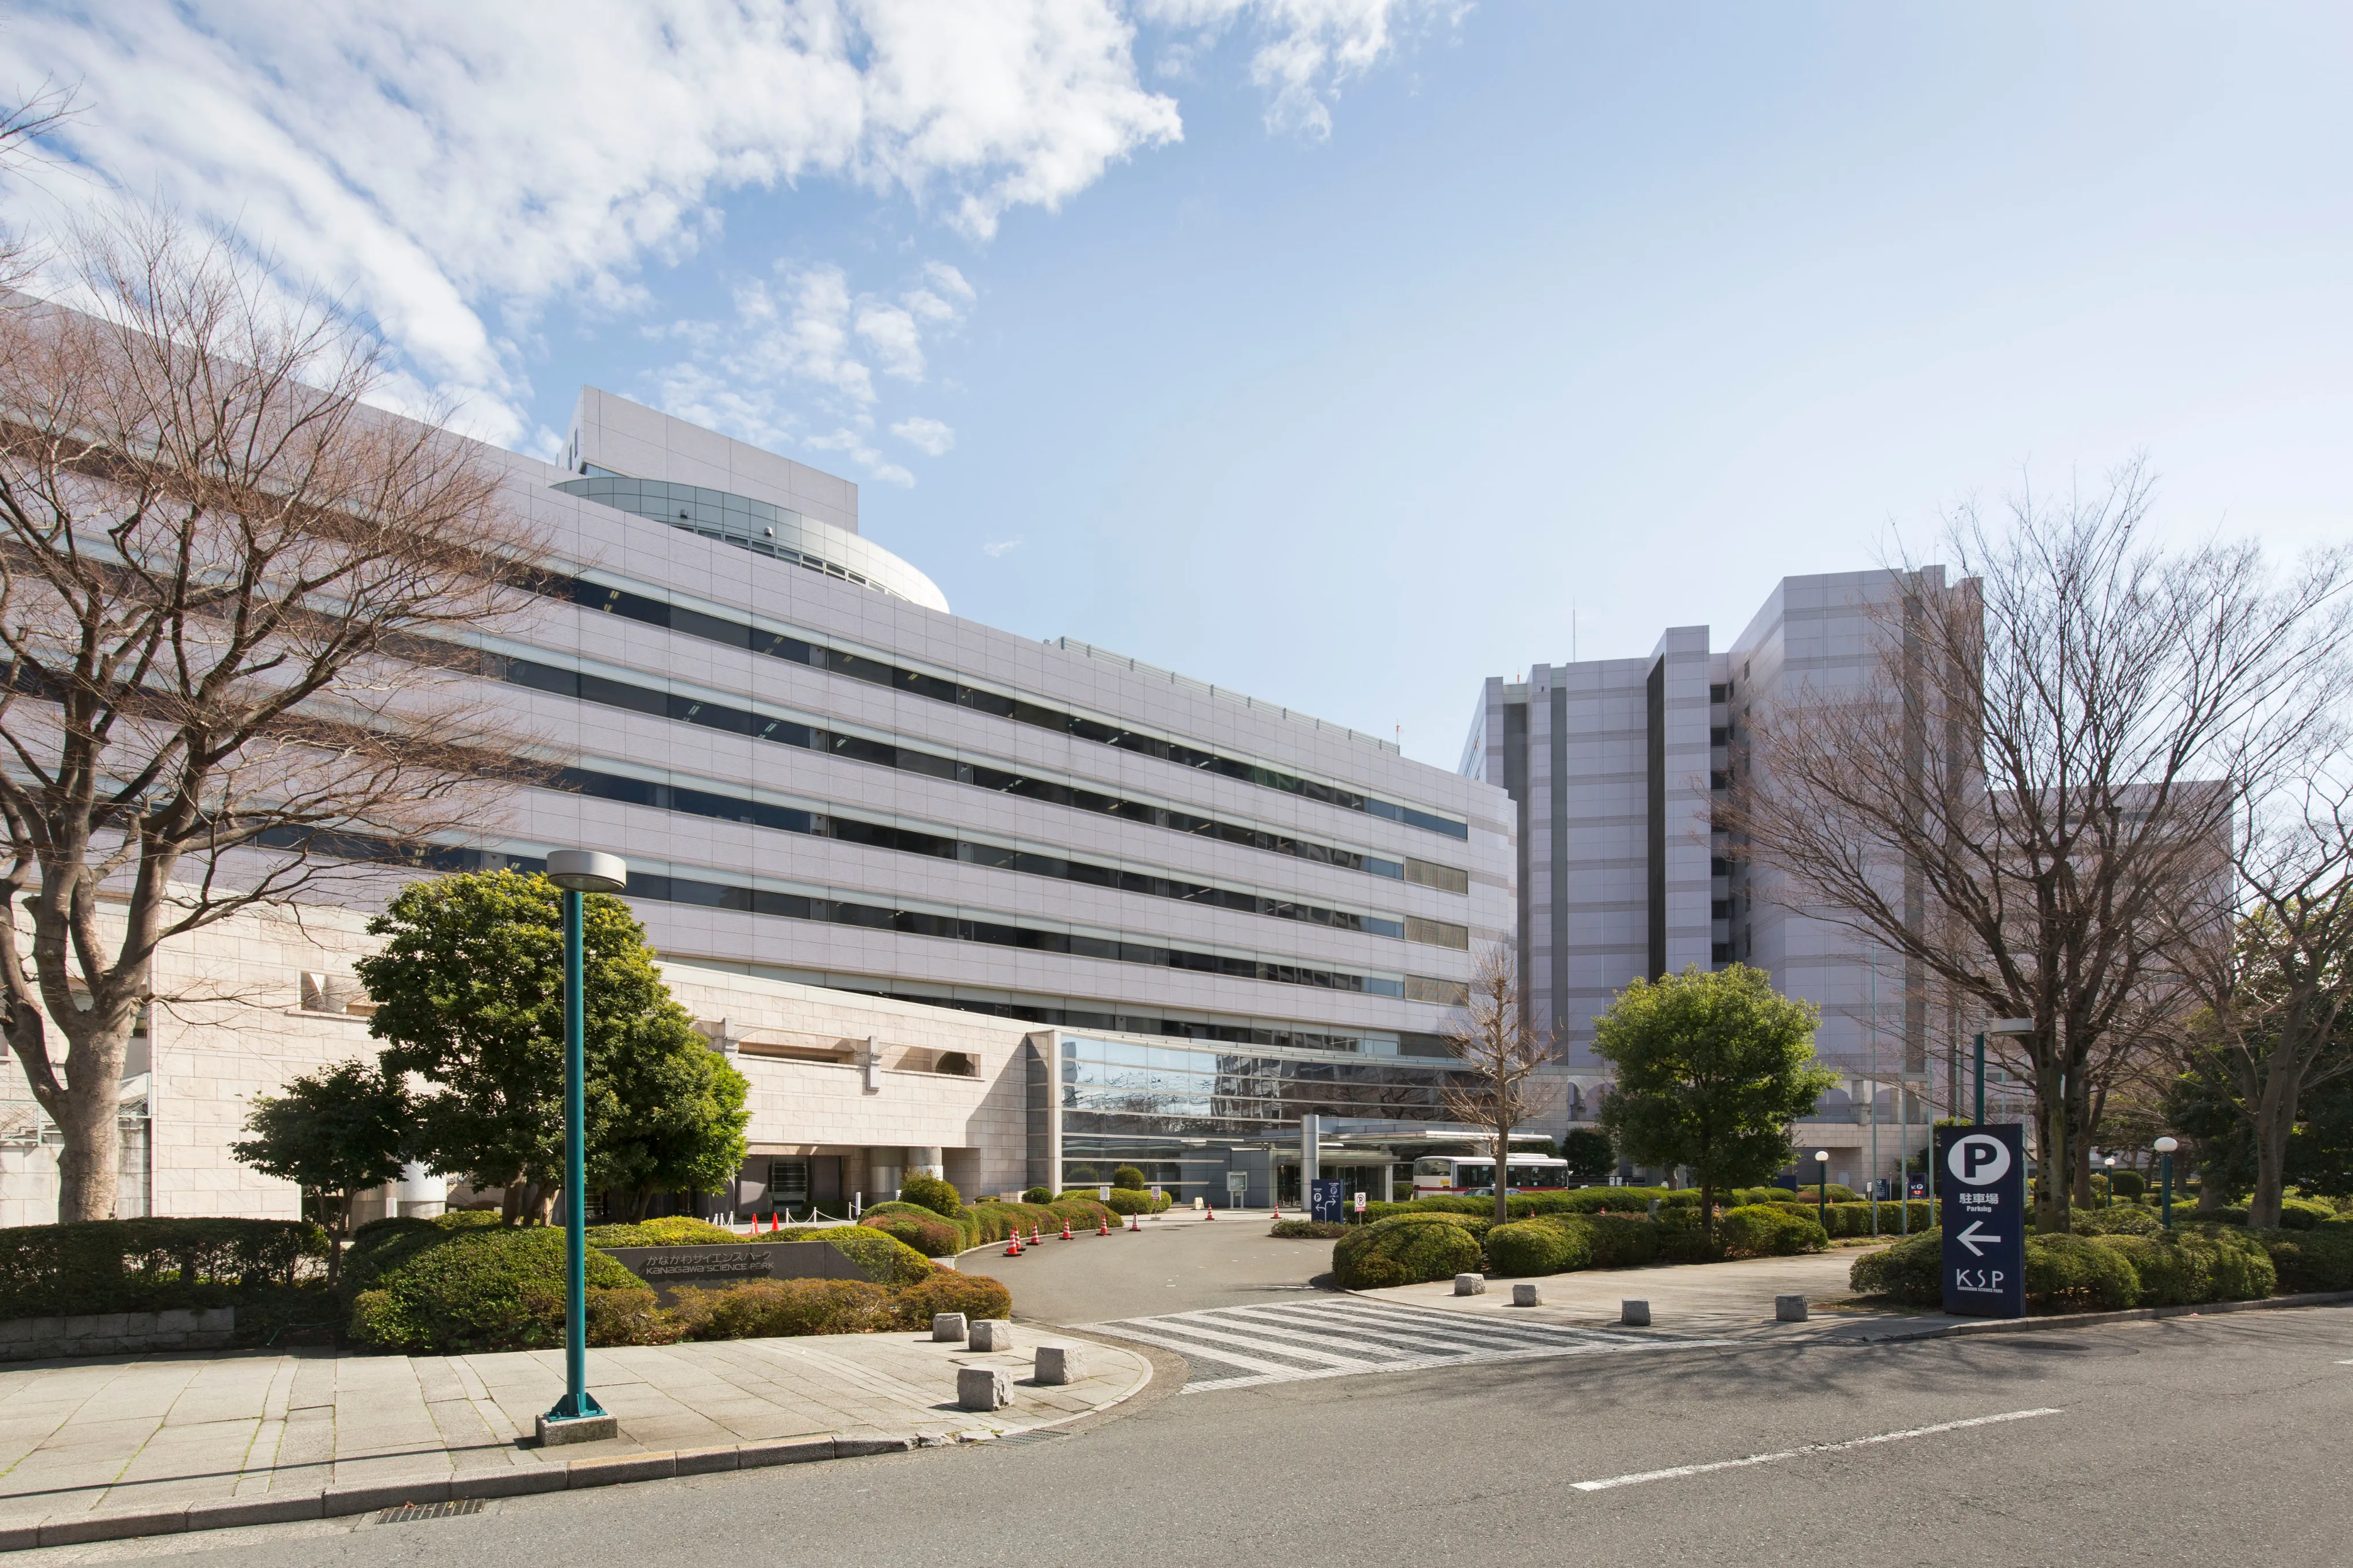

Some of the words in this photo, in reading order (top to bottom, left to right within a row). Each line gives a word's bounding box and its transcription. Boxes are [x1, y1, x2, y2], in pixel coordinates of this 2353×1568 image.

[1964, 1142, 1997, 1178] P
[1959, 1193, 1999, 1204] 駐車場
[706, 1264, 747, 1272] SCIENCE
[1956, 1268, 2004, 1288] KSP
